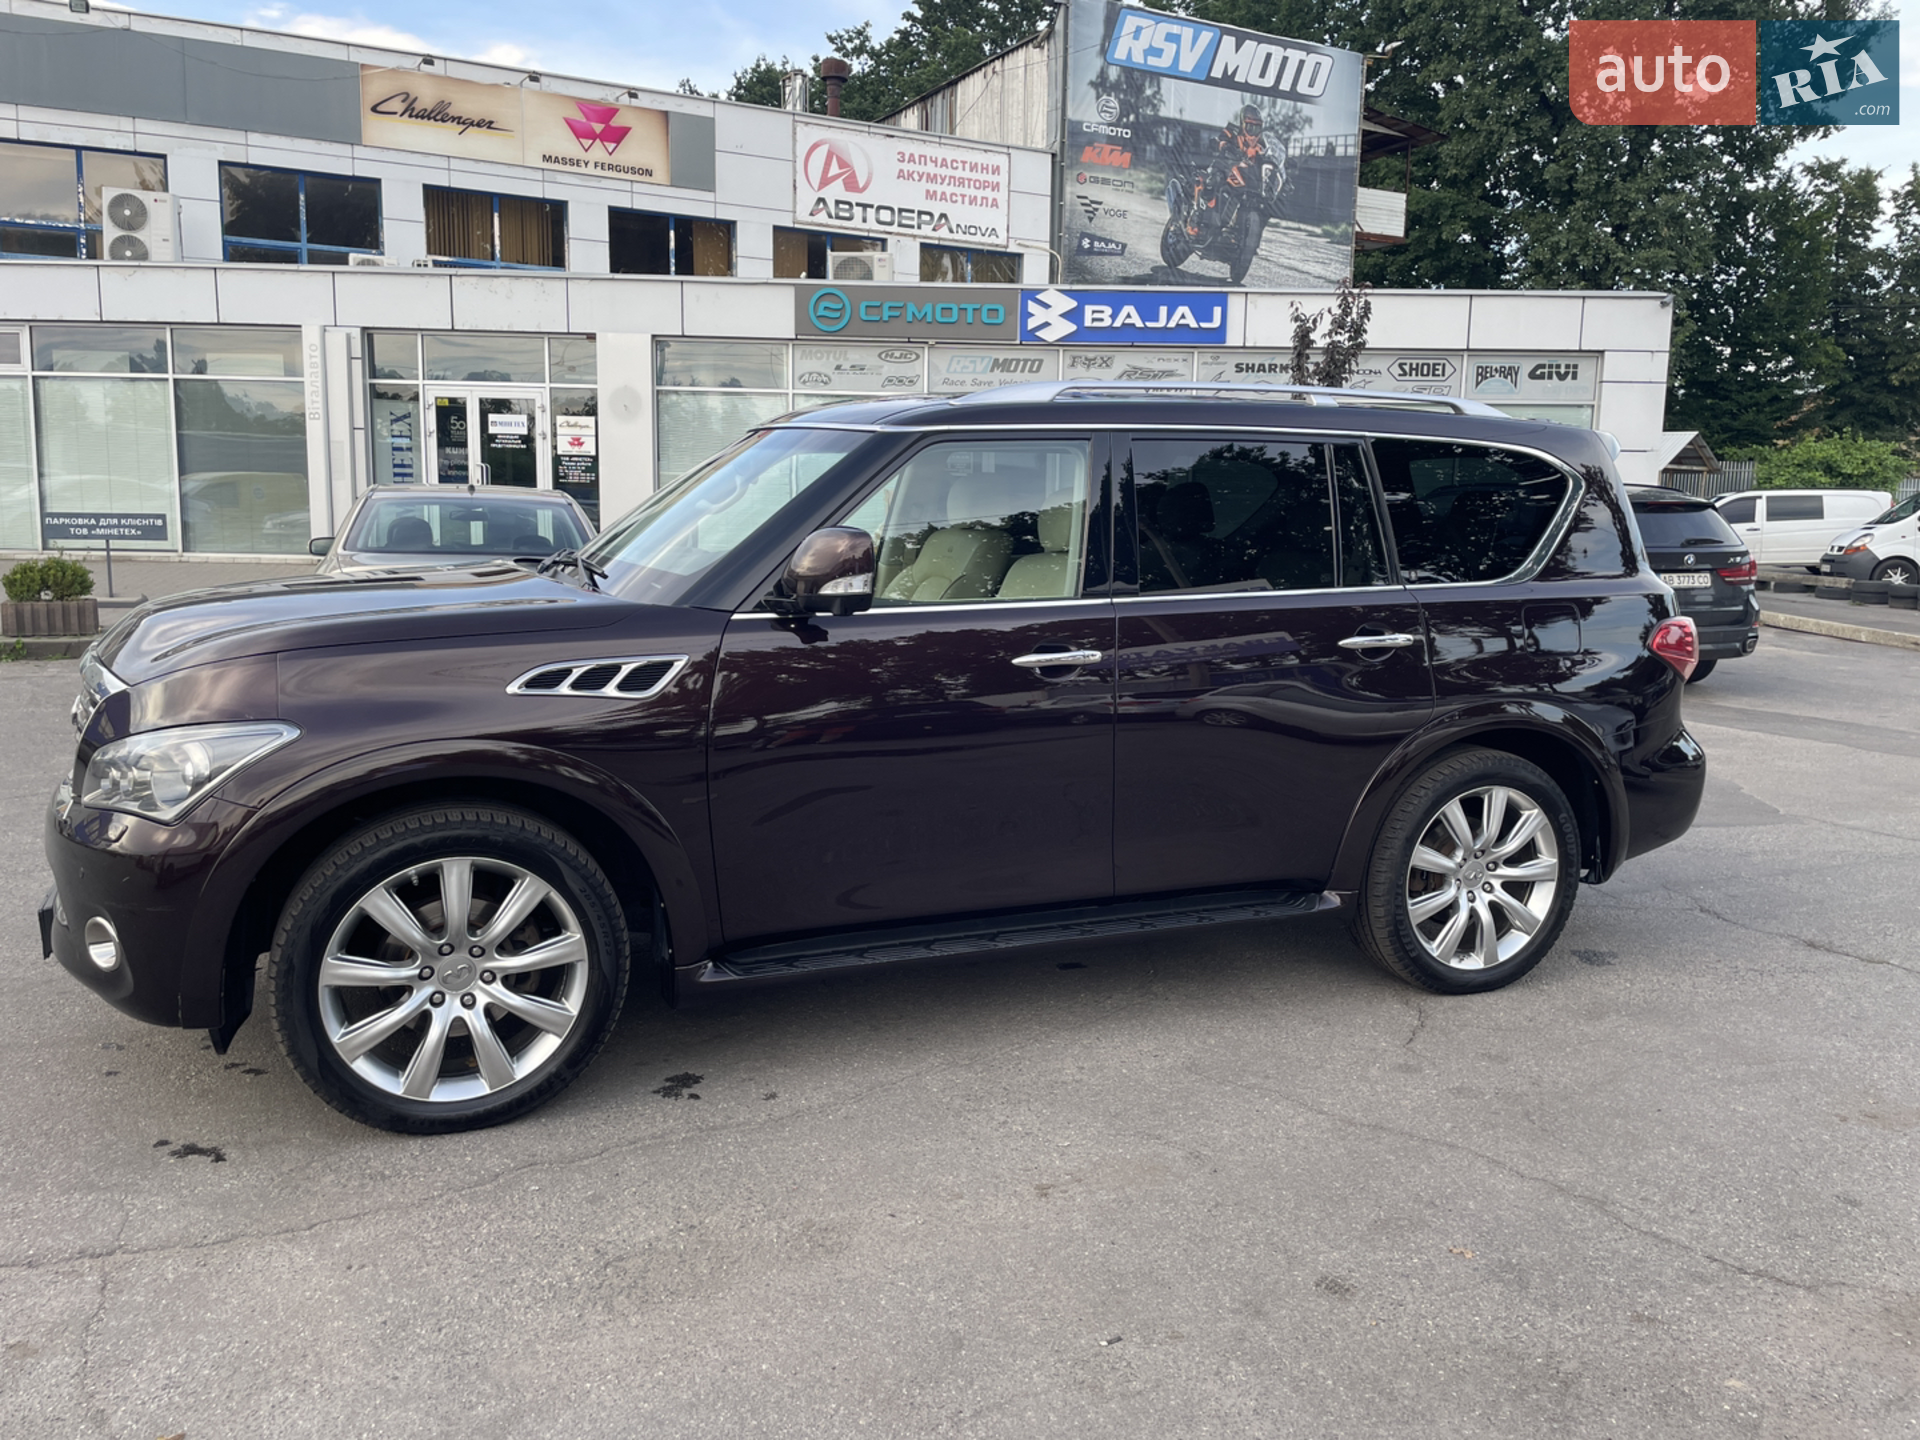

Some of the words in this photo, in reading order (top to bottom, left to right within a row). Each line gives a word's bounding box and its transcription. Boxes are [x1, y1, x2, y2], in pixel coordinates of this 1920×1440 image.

[370, 91, 515, 136] Challenger
[1082, 122, 1132, 138] CFMOTO
[896, 151, 1001, 176] ЗАПЧАСТИНИ
[1081, 142, 1132, 169] KTM
[542, 153, 590, 169] MASSEY
[594, 160, 653, 177] FERGUSON
[896, 168, 1001, 193] АКУМУЛЯТОРИ
[925, 189, 1000, 210] МАСТИЛА
[1103, 207, 1129, 220] VOGE
[1093, 240, 1123, 251] BAJAJ
[858, 300, 1006, 325] CFMOTO
[1083, 304, 1223, 329] BAJAJ
[800, 349, 850, 361] MOTUL
[883, 351, 914, 360] HJC
[1397, 362, 1447, 378] SHOEI
[45, 517, 97, 526] ПАРКОВКА
[98, 518, 119, 527] ДЛЯ
[120, 518, 164, 527] КЛІЄНТІВ
[69, 527, 89, 535] ТОВ
